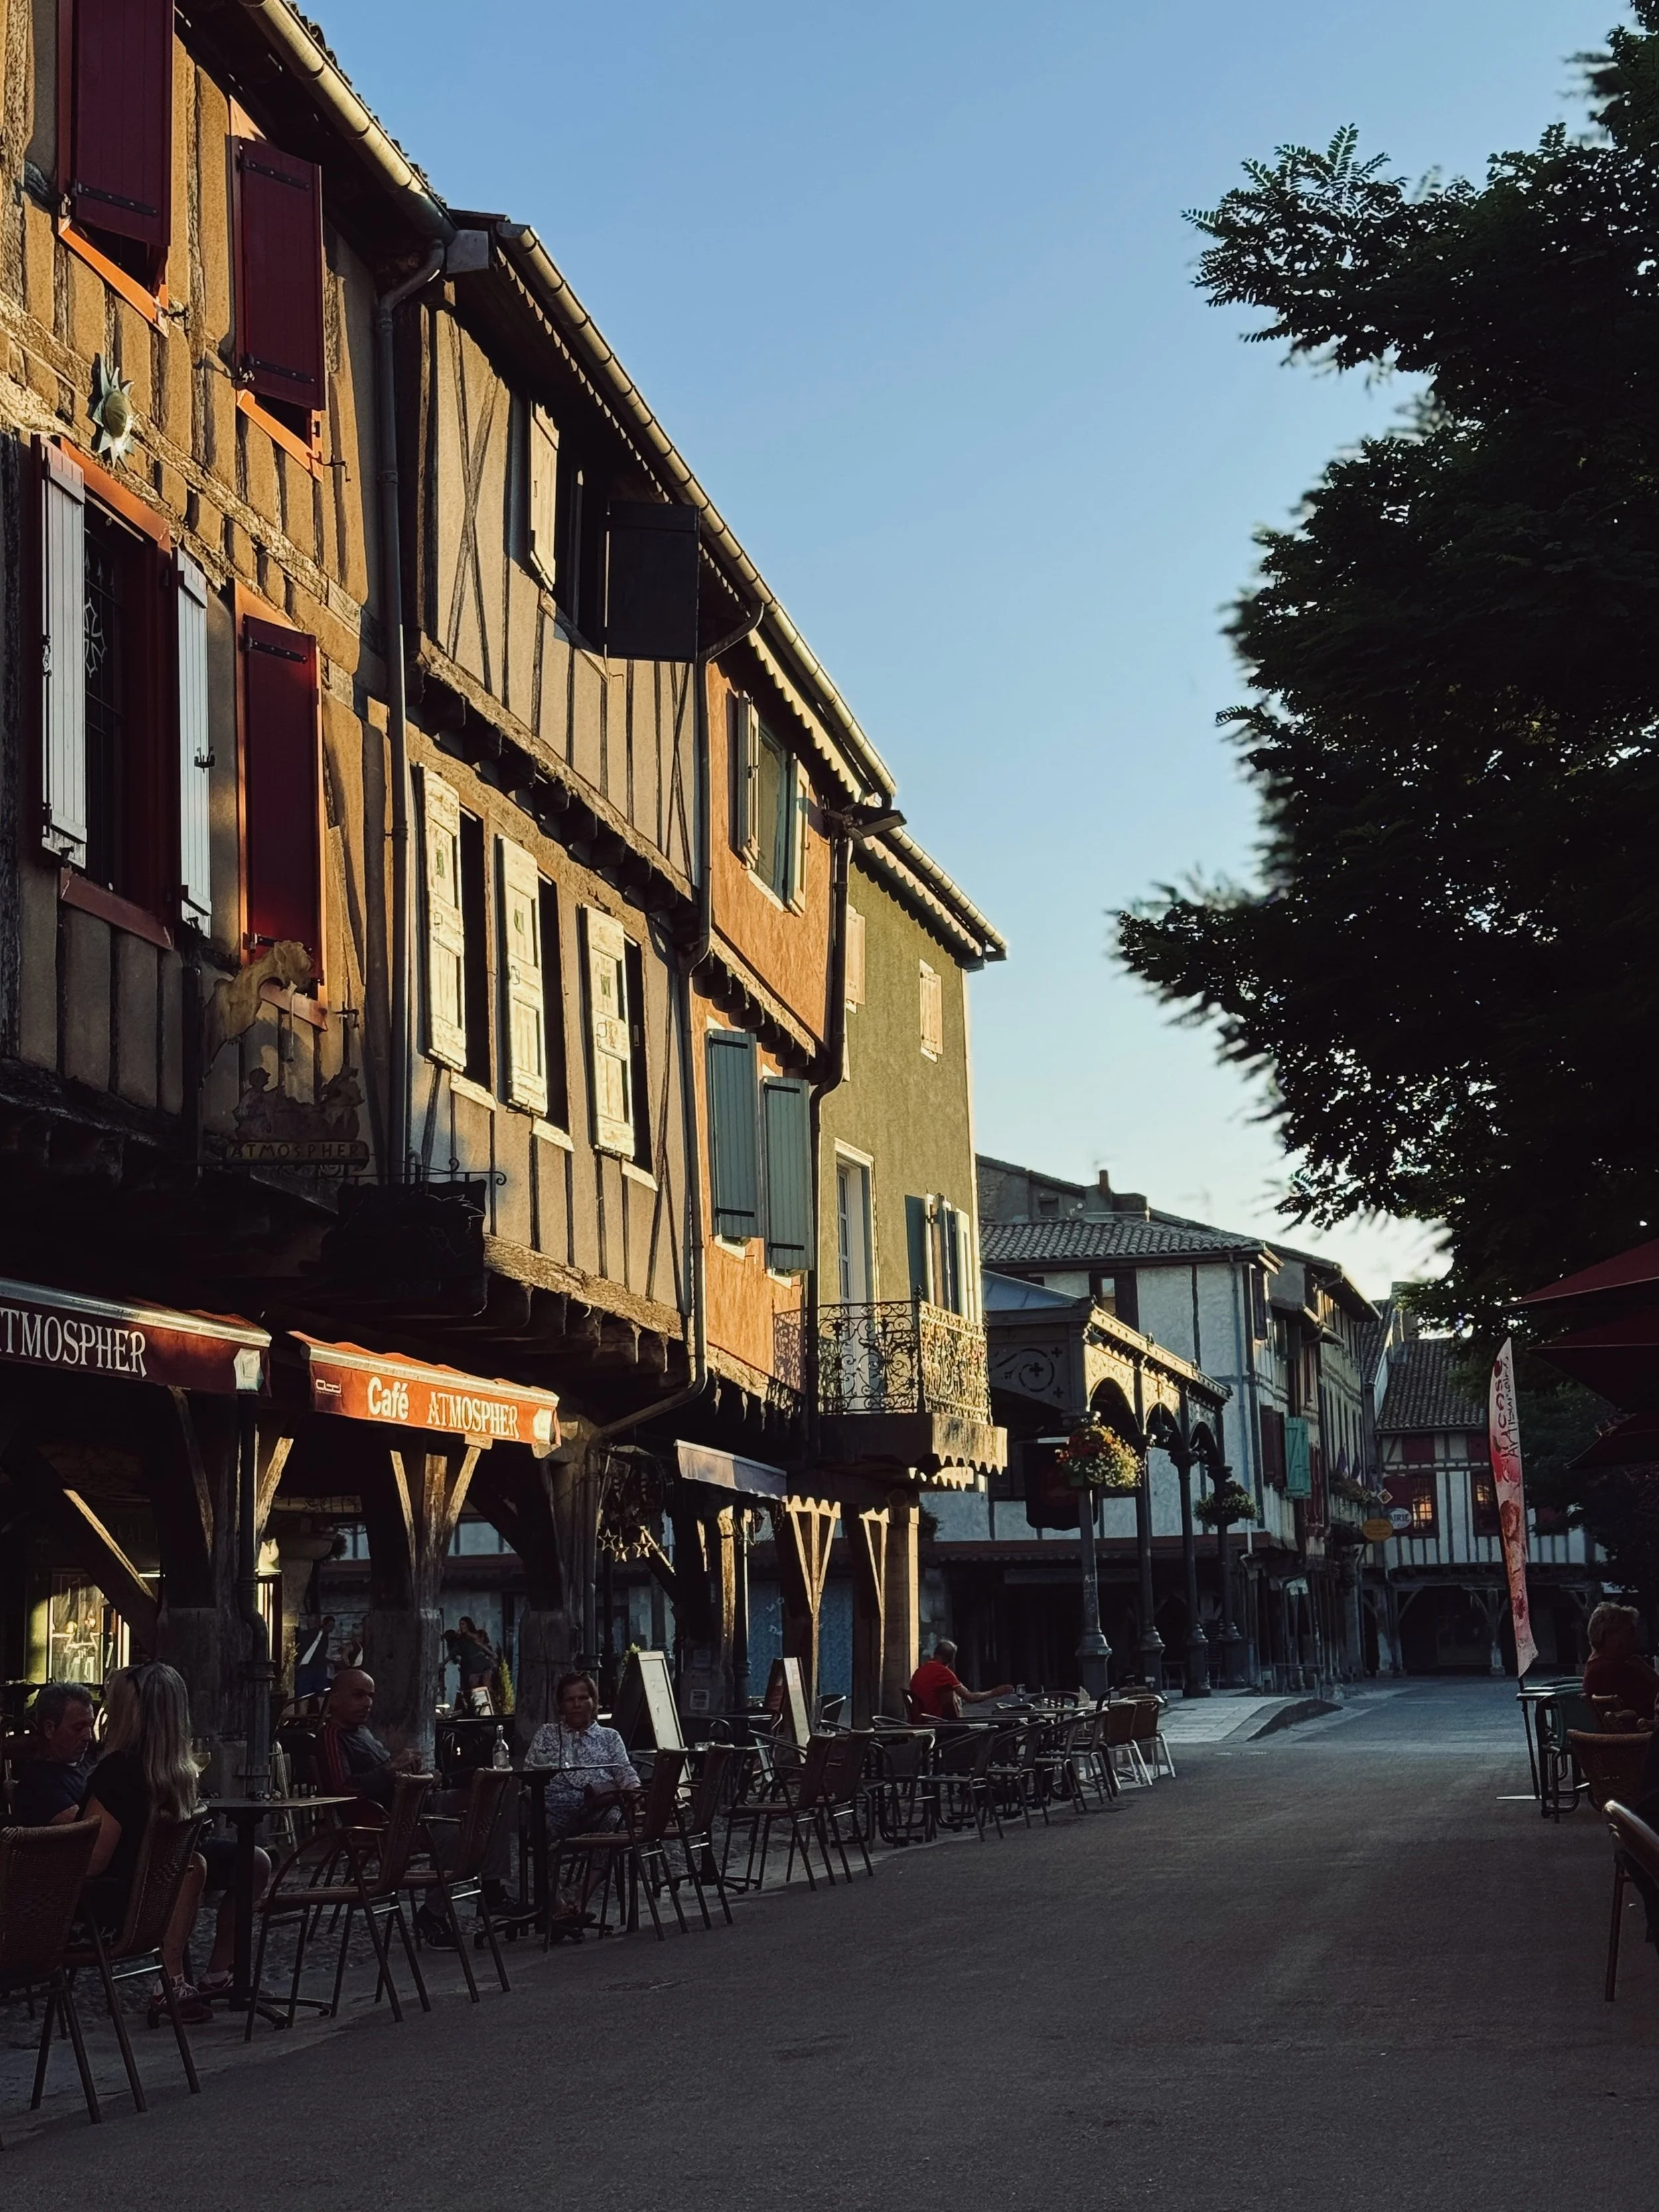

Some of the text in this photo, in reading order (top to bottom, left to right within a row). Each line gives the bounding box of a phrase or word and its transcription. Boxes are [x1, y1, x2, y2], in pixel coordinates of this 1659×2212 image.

[230, 1143, 359, 1159] ATMOSPHER
[0, 1306, 147, 1378] TMOSPHER
[367, 1376, 409, 1420] Café
[426, 1390, 520, 1440] ATMOSPHER
